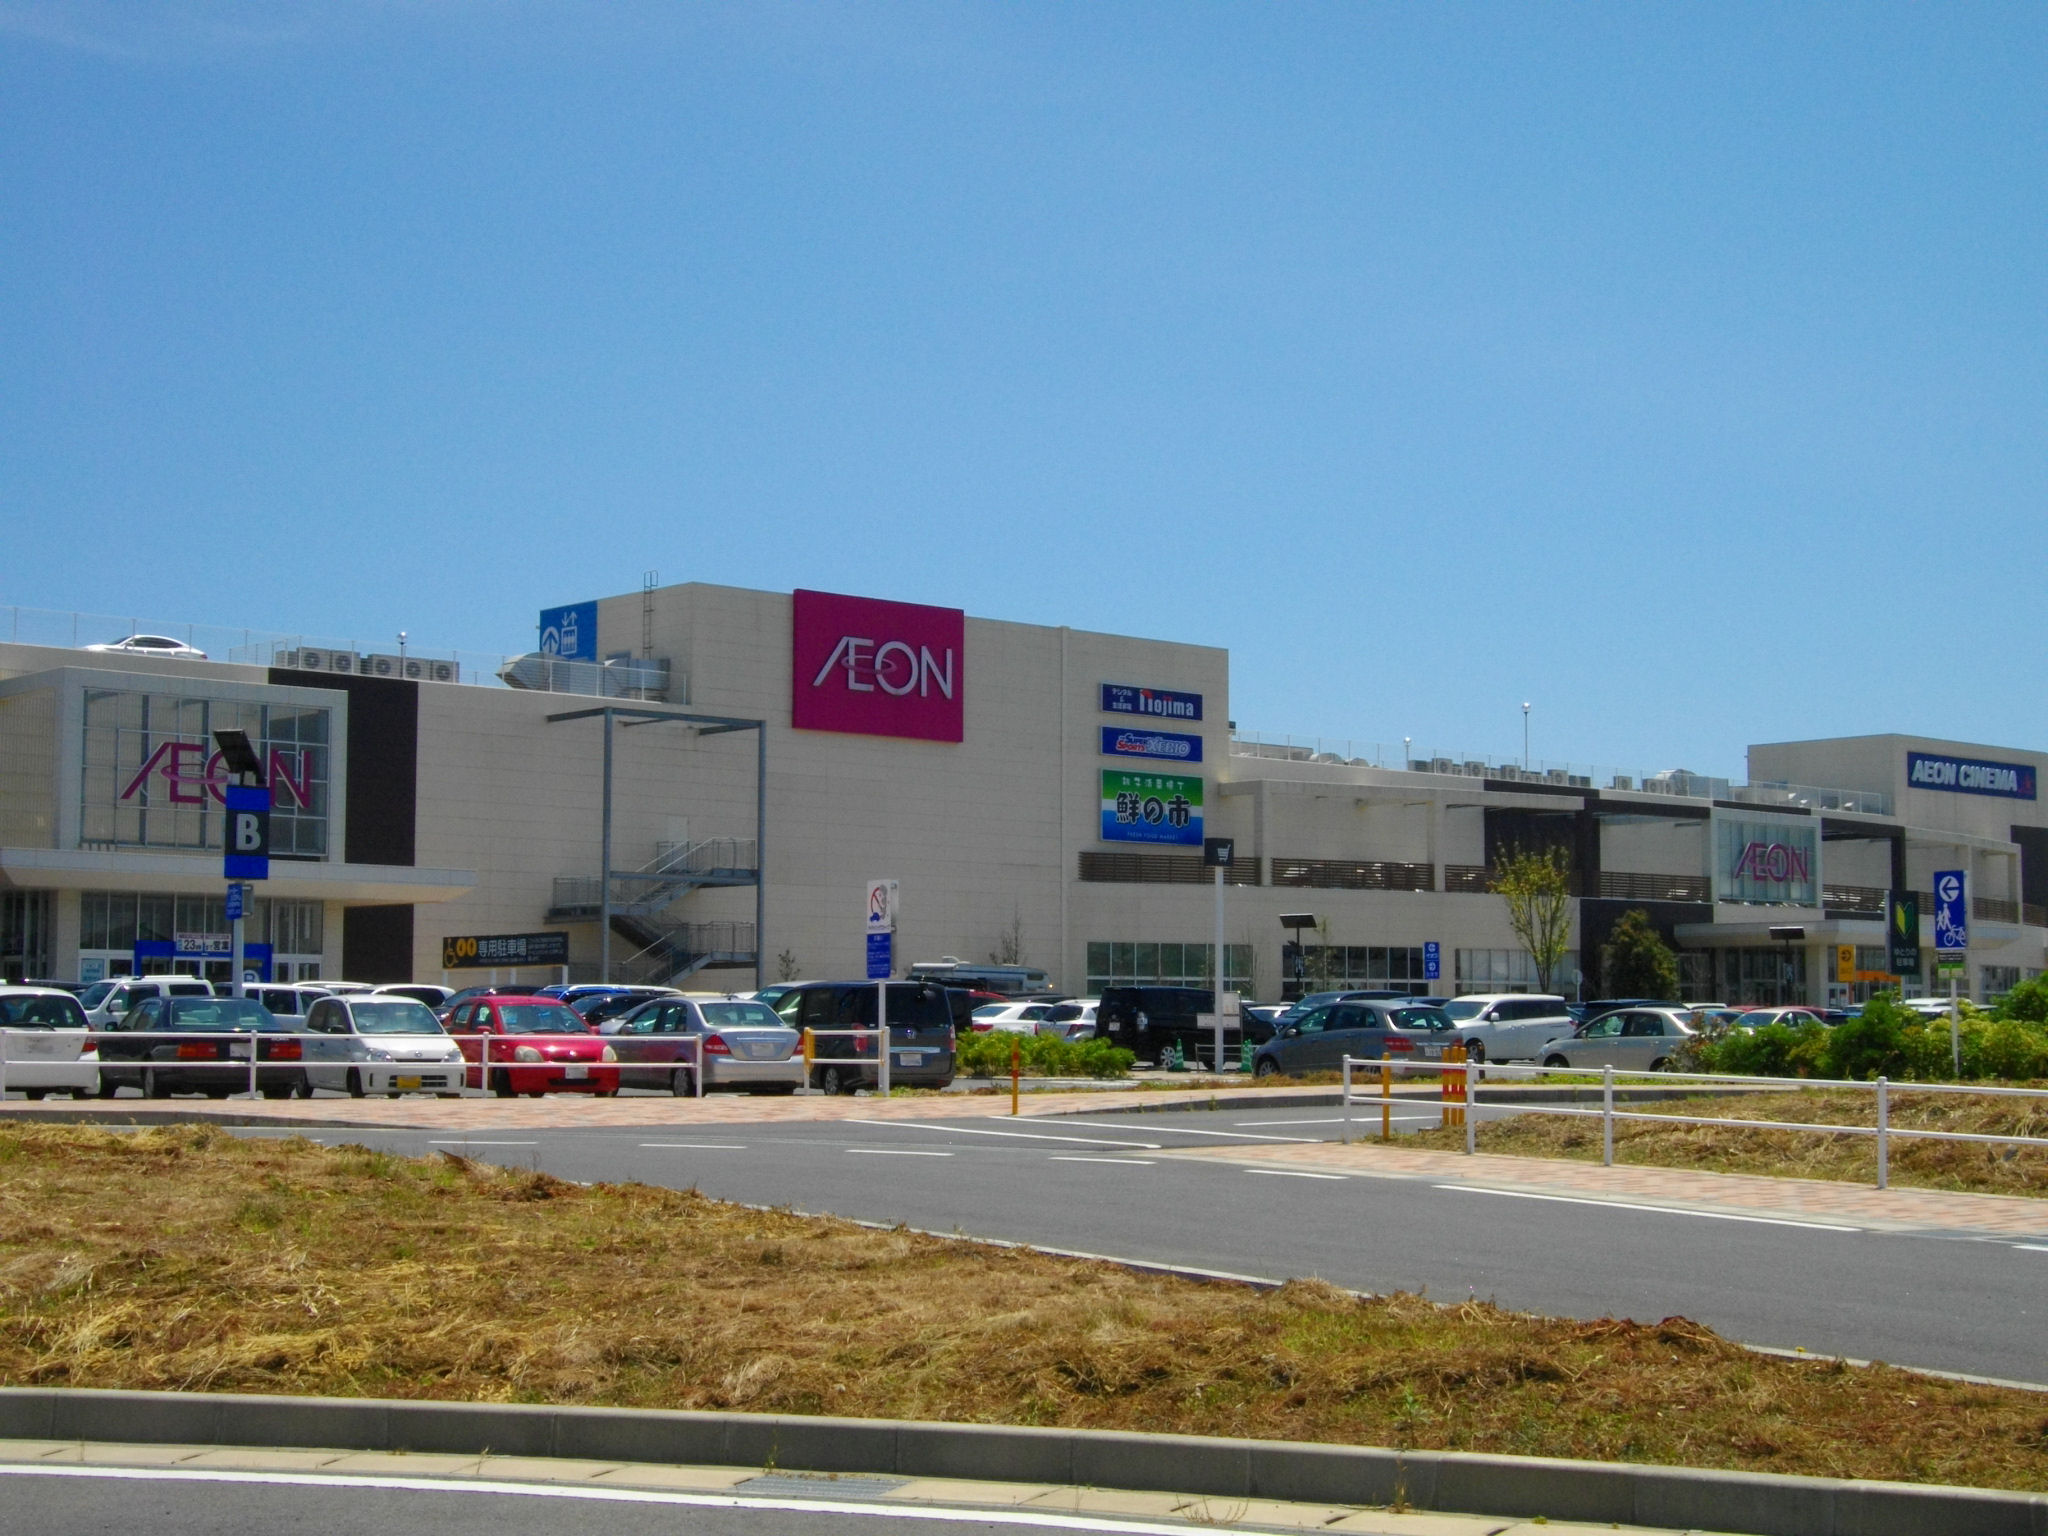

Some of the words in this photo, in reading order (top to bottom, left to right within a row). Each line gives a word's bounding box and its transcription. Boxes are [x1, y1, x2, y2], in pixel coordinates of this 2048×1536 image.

[1147, 738, 1190, 756] XEBIO
[1911, 759, 1957, 786] AEON
[1959, 764, 2018, 791] CINEMA
[1116, 792, 1192, 828] 鮮の市
[236, 813, 262, 850] B
[478, 938, 527, 957] 専用駐車場
